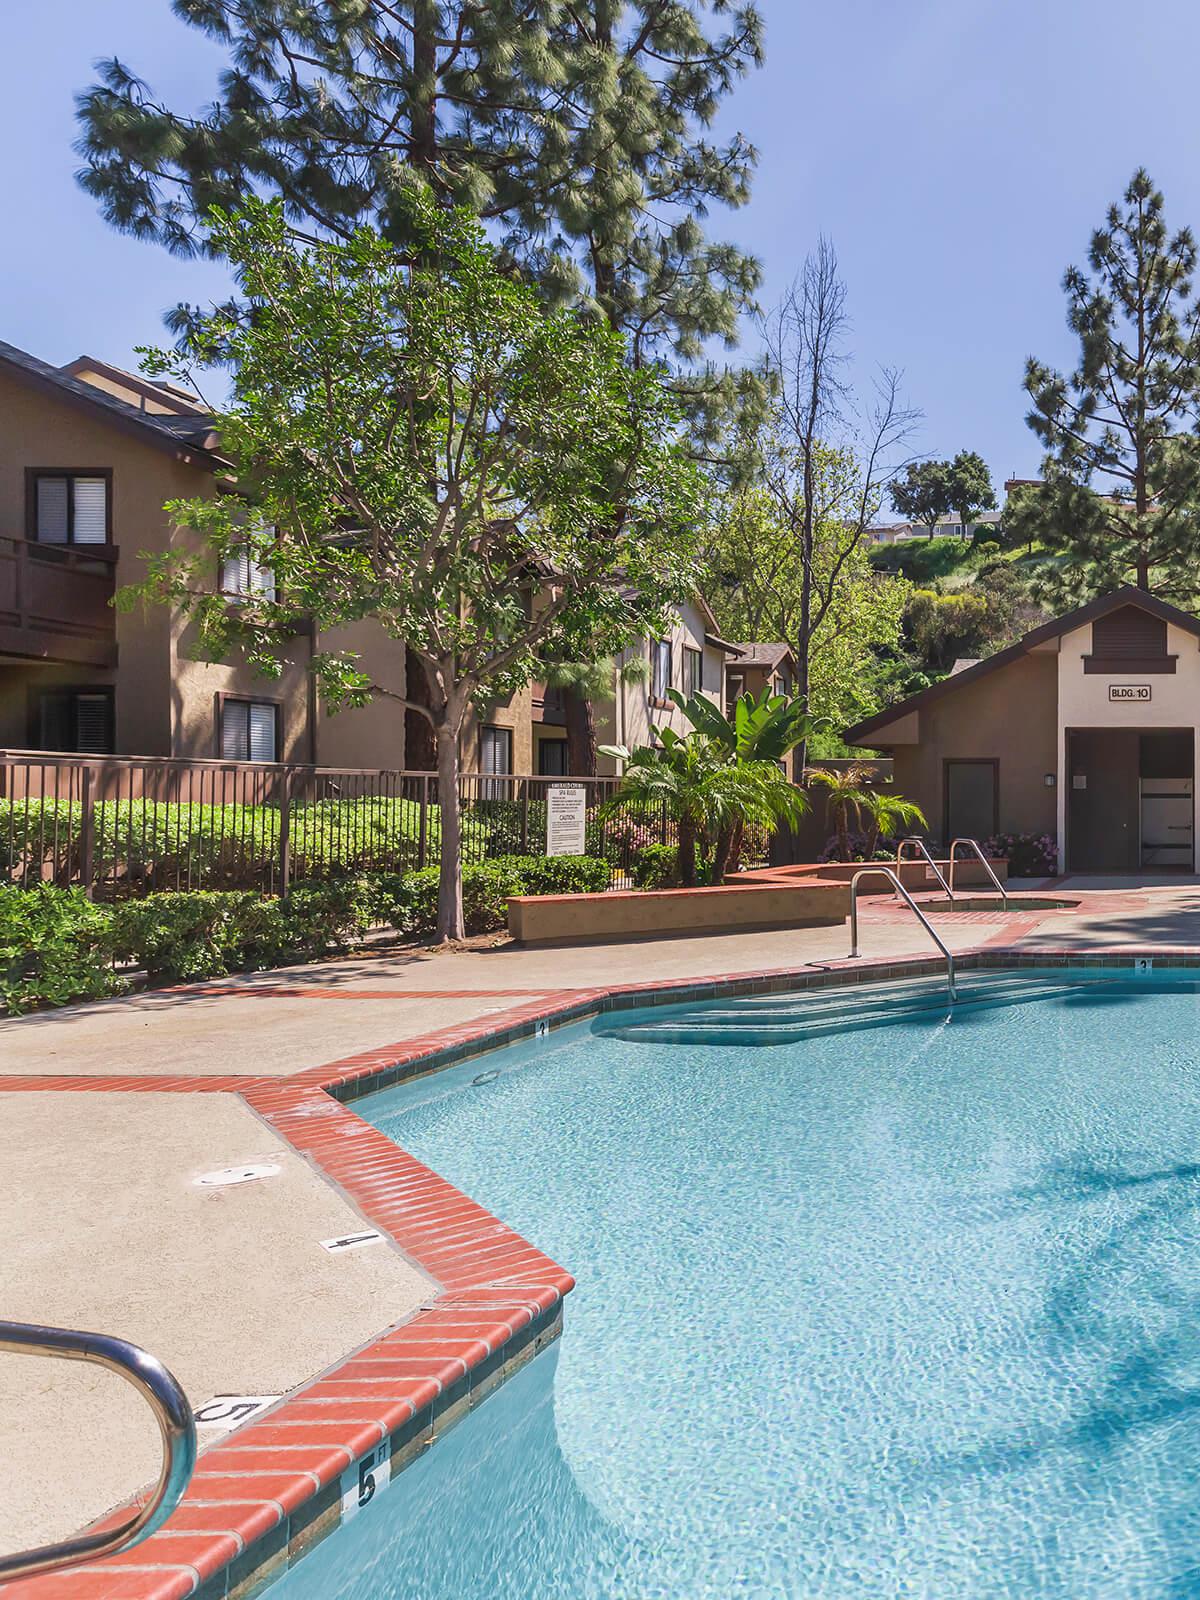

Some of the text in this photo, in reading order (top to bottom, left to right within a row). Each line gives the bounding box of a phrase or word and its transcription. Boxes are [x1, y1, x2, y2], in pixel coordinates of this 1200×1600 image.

[1112, 689, 1148, 698] BLDG. 10
[359, 1442, 387, 1508] 5 FT
